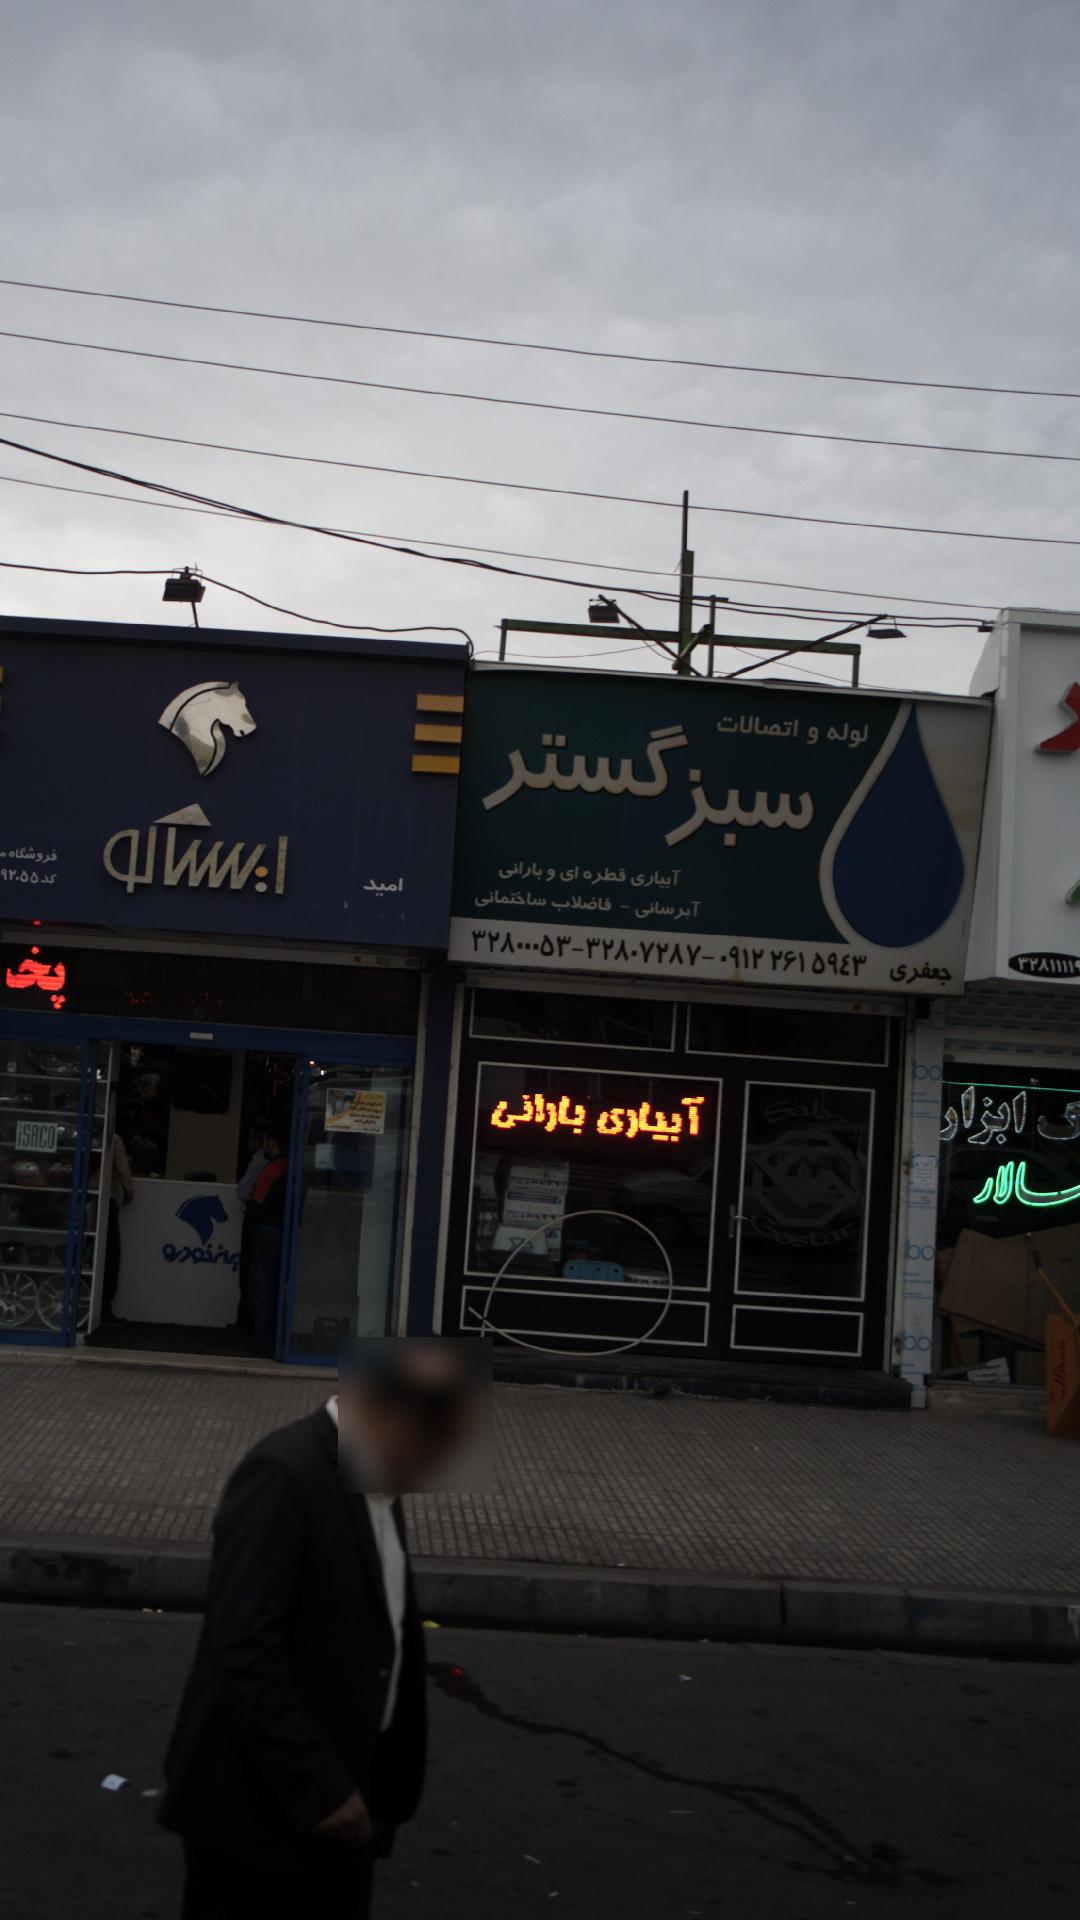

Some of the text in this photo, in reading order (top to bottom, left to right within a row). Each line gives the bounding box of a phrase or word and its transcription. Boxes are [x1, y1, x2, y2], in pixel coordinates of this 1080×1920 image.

[715, 713, 870, 748] لوله و اتصالات
[480, 723, 816, 849] سبز گستر
[497, 860, 544, 881] بارانی
[545, 867, 557, 882] و
[582, 866, 627, 886] قطره
[629, 868, 683, 889] آبیاری
[361, 876, 405, 897] امید
[473, 888, 547, 907] ساختمانی
[550, 894, 613, 913] فاضلاب
[634, 899, 703, 920] آبرسانی
[888, 961, 953, 986] جعفری
[490, 1092, 706, 1143] آبیاری بارانی
